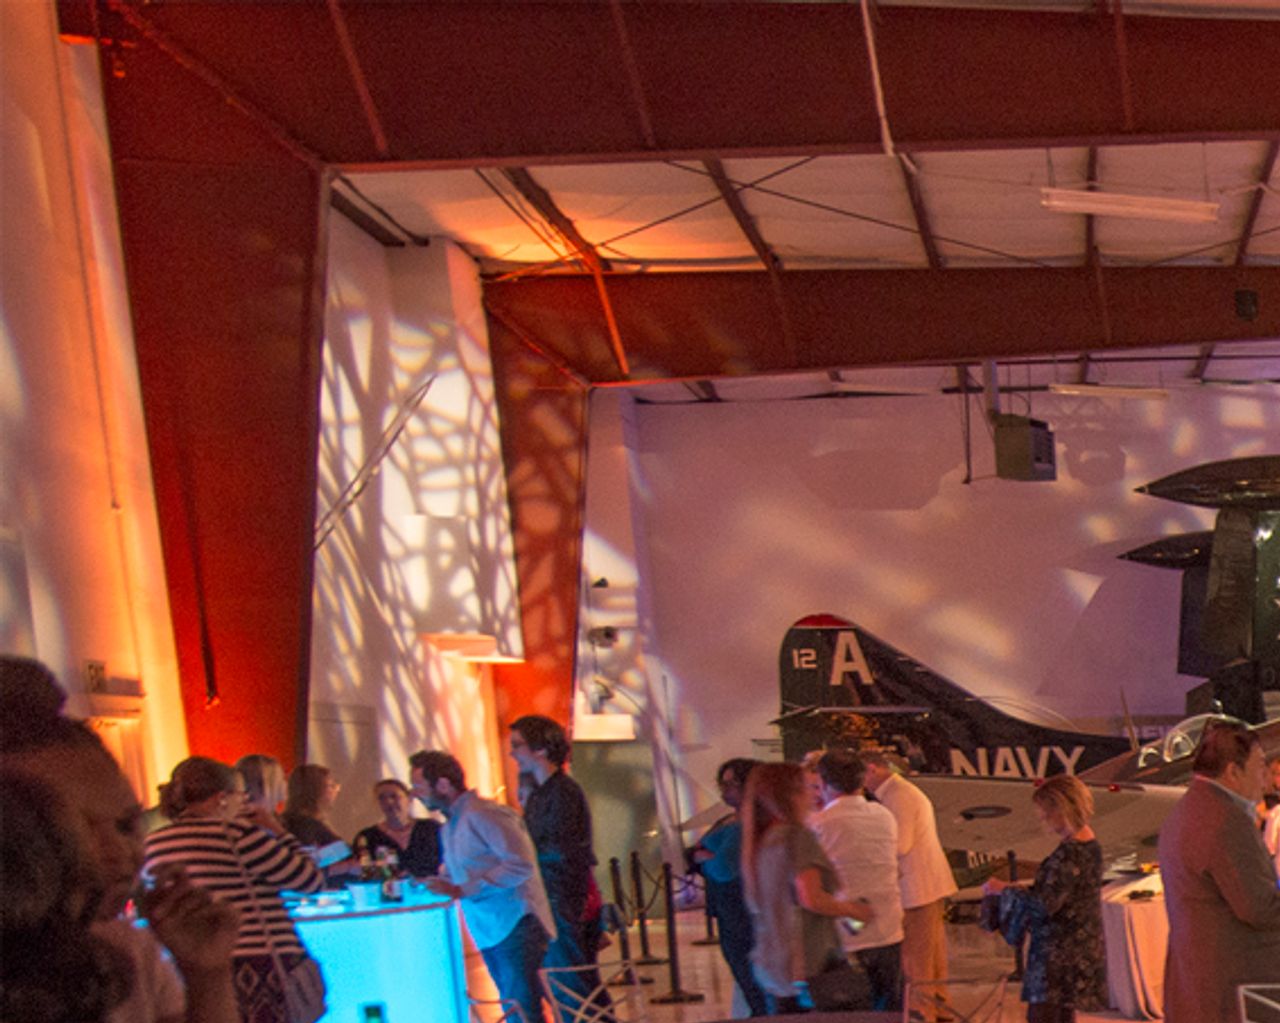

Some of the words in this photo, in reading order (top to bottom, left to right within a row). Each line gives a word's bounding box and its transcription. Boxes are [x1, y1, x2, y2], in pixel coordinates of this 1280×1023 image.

[792, 648, 817, 669] 12
[829, 630, 874, 686] A
[950, 746, 1085, 779] NAVY
